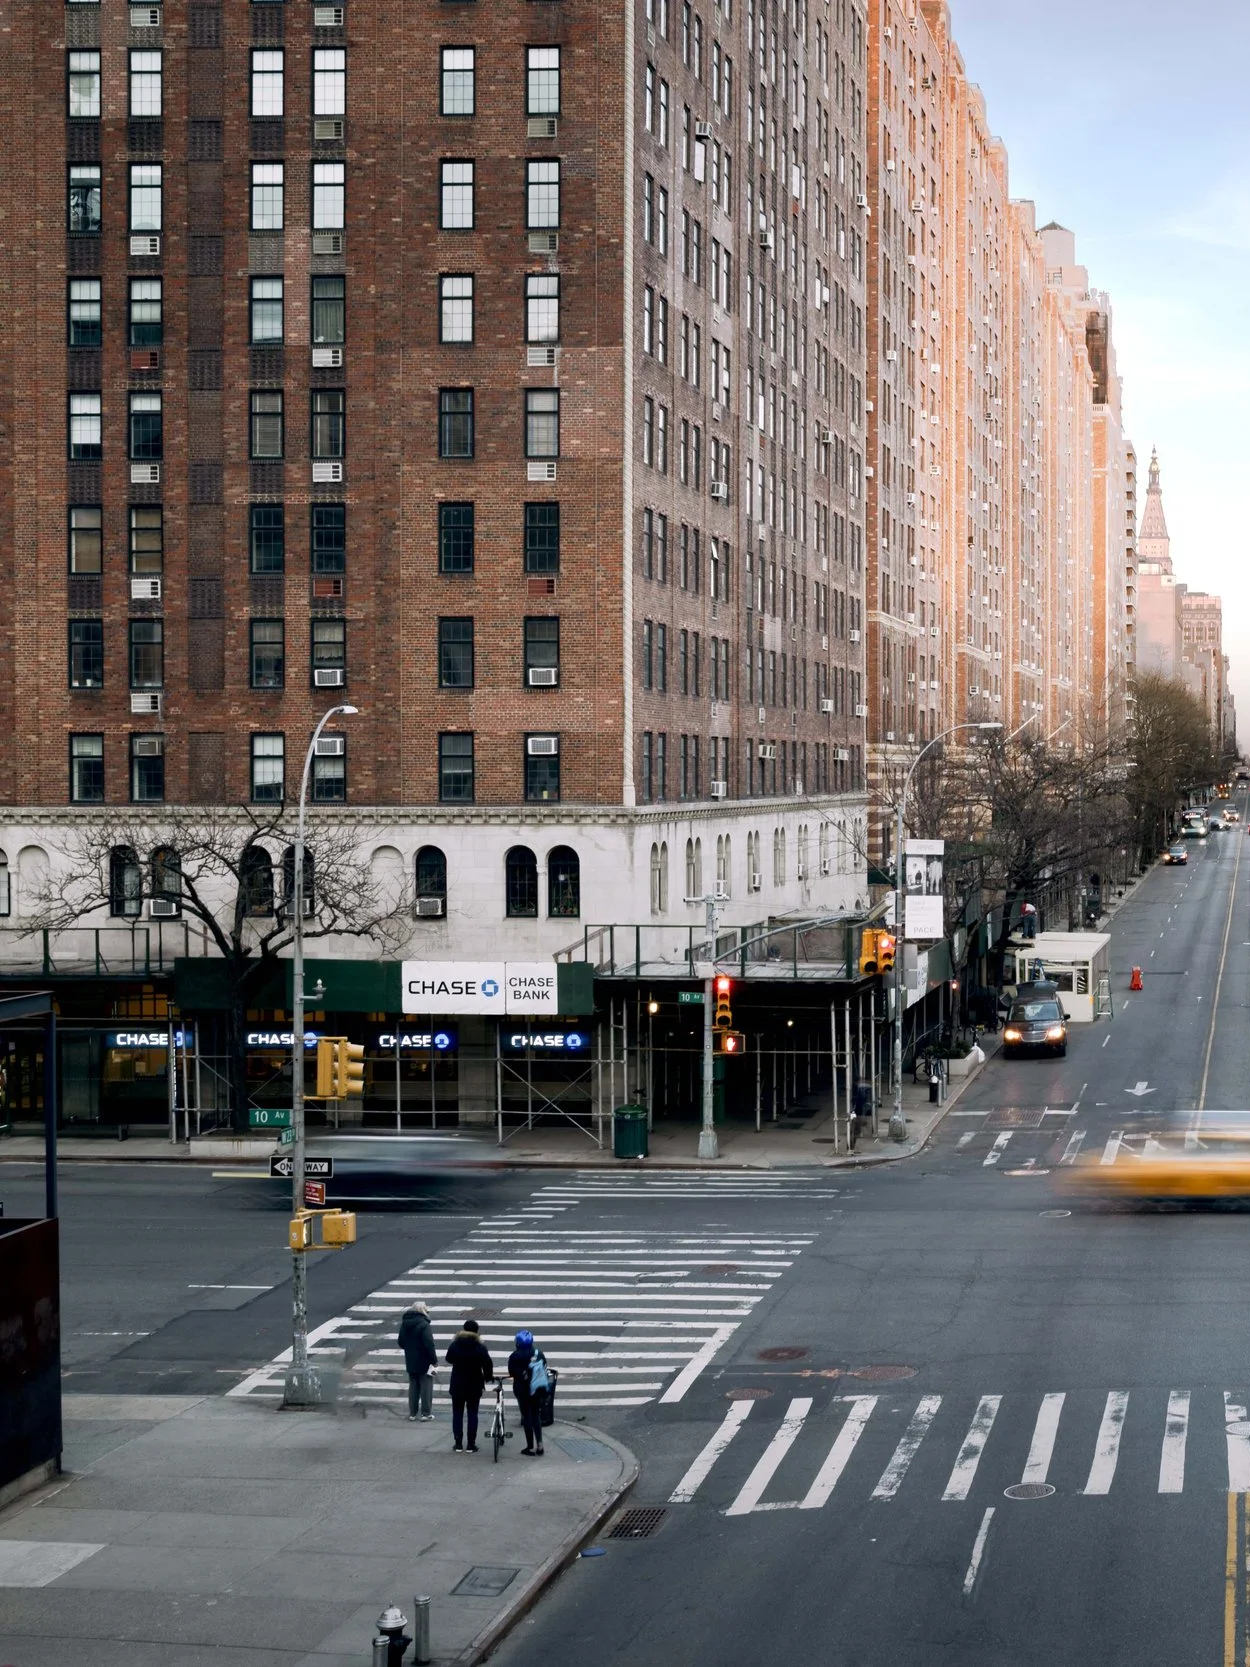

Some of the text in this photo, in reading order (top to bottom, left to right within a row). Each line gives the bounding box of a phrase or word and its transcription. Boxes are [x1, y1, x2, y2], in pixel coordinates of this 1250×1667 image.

[913, 926, 934, 934] PACE
[408, 980, 477, 995] CHASE
[508, 977, 554, 987] CHASE
[513, 990, 551, 1000] BANK
[682, 993, 690, 1001] 10
[116, 1033, 168, 1045] CHASE
[247, 1033, 295, 1045] CHAS
[379, 1034, 432, 1047] CHASE
[511, 1034, 564, 1047] CHASE
[254, 1111, 285, 1123] 10 Av
[280, 1163, 324, 1171] ON WAY
